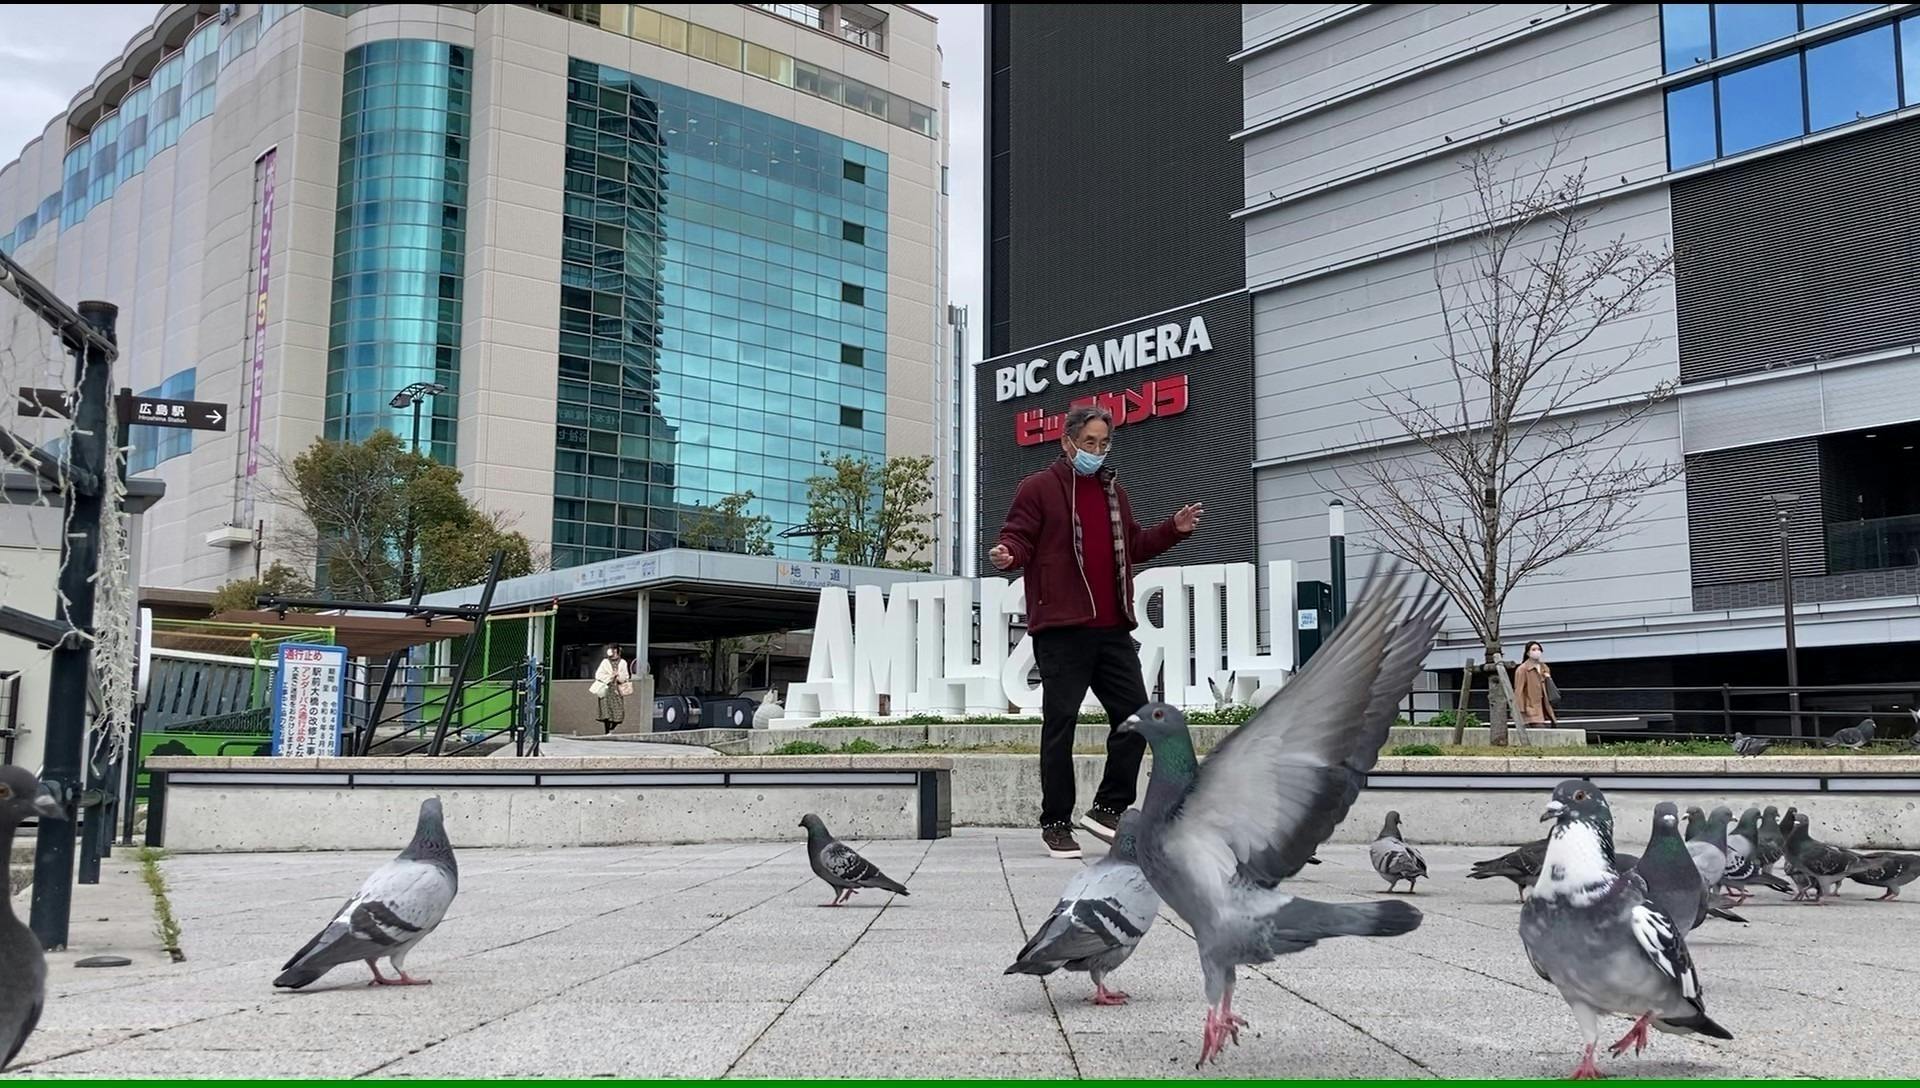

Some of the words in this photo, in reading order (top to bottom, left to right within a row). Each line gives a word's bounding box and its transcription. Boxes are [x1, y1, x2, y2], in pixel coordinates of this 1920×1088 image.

[996, 358, 1049, 402] BIC
[1056, 315, 1213, 386] CAMERA
[139, 402, 185, 417] 広島駅
[1016, 373, 1188, 447] ビッカメラ
[138, 414, 167, 422] Hiroshima
[167, 416, 188, 424] Station
[791, 564, 841, 581] 地下道
[284, 649, 322, 661] 通行止め
